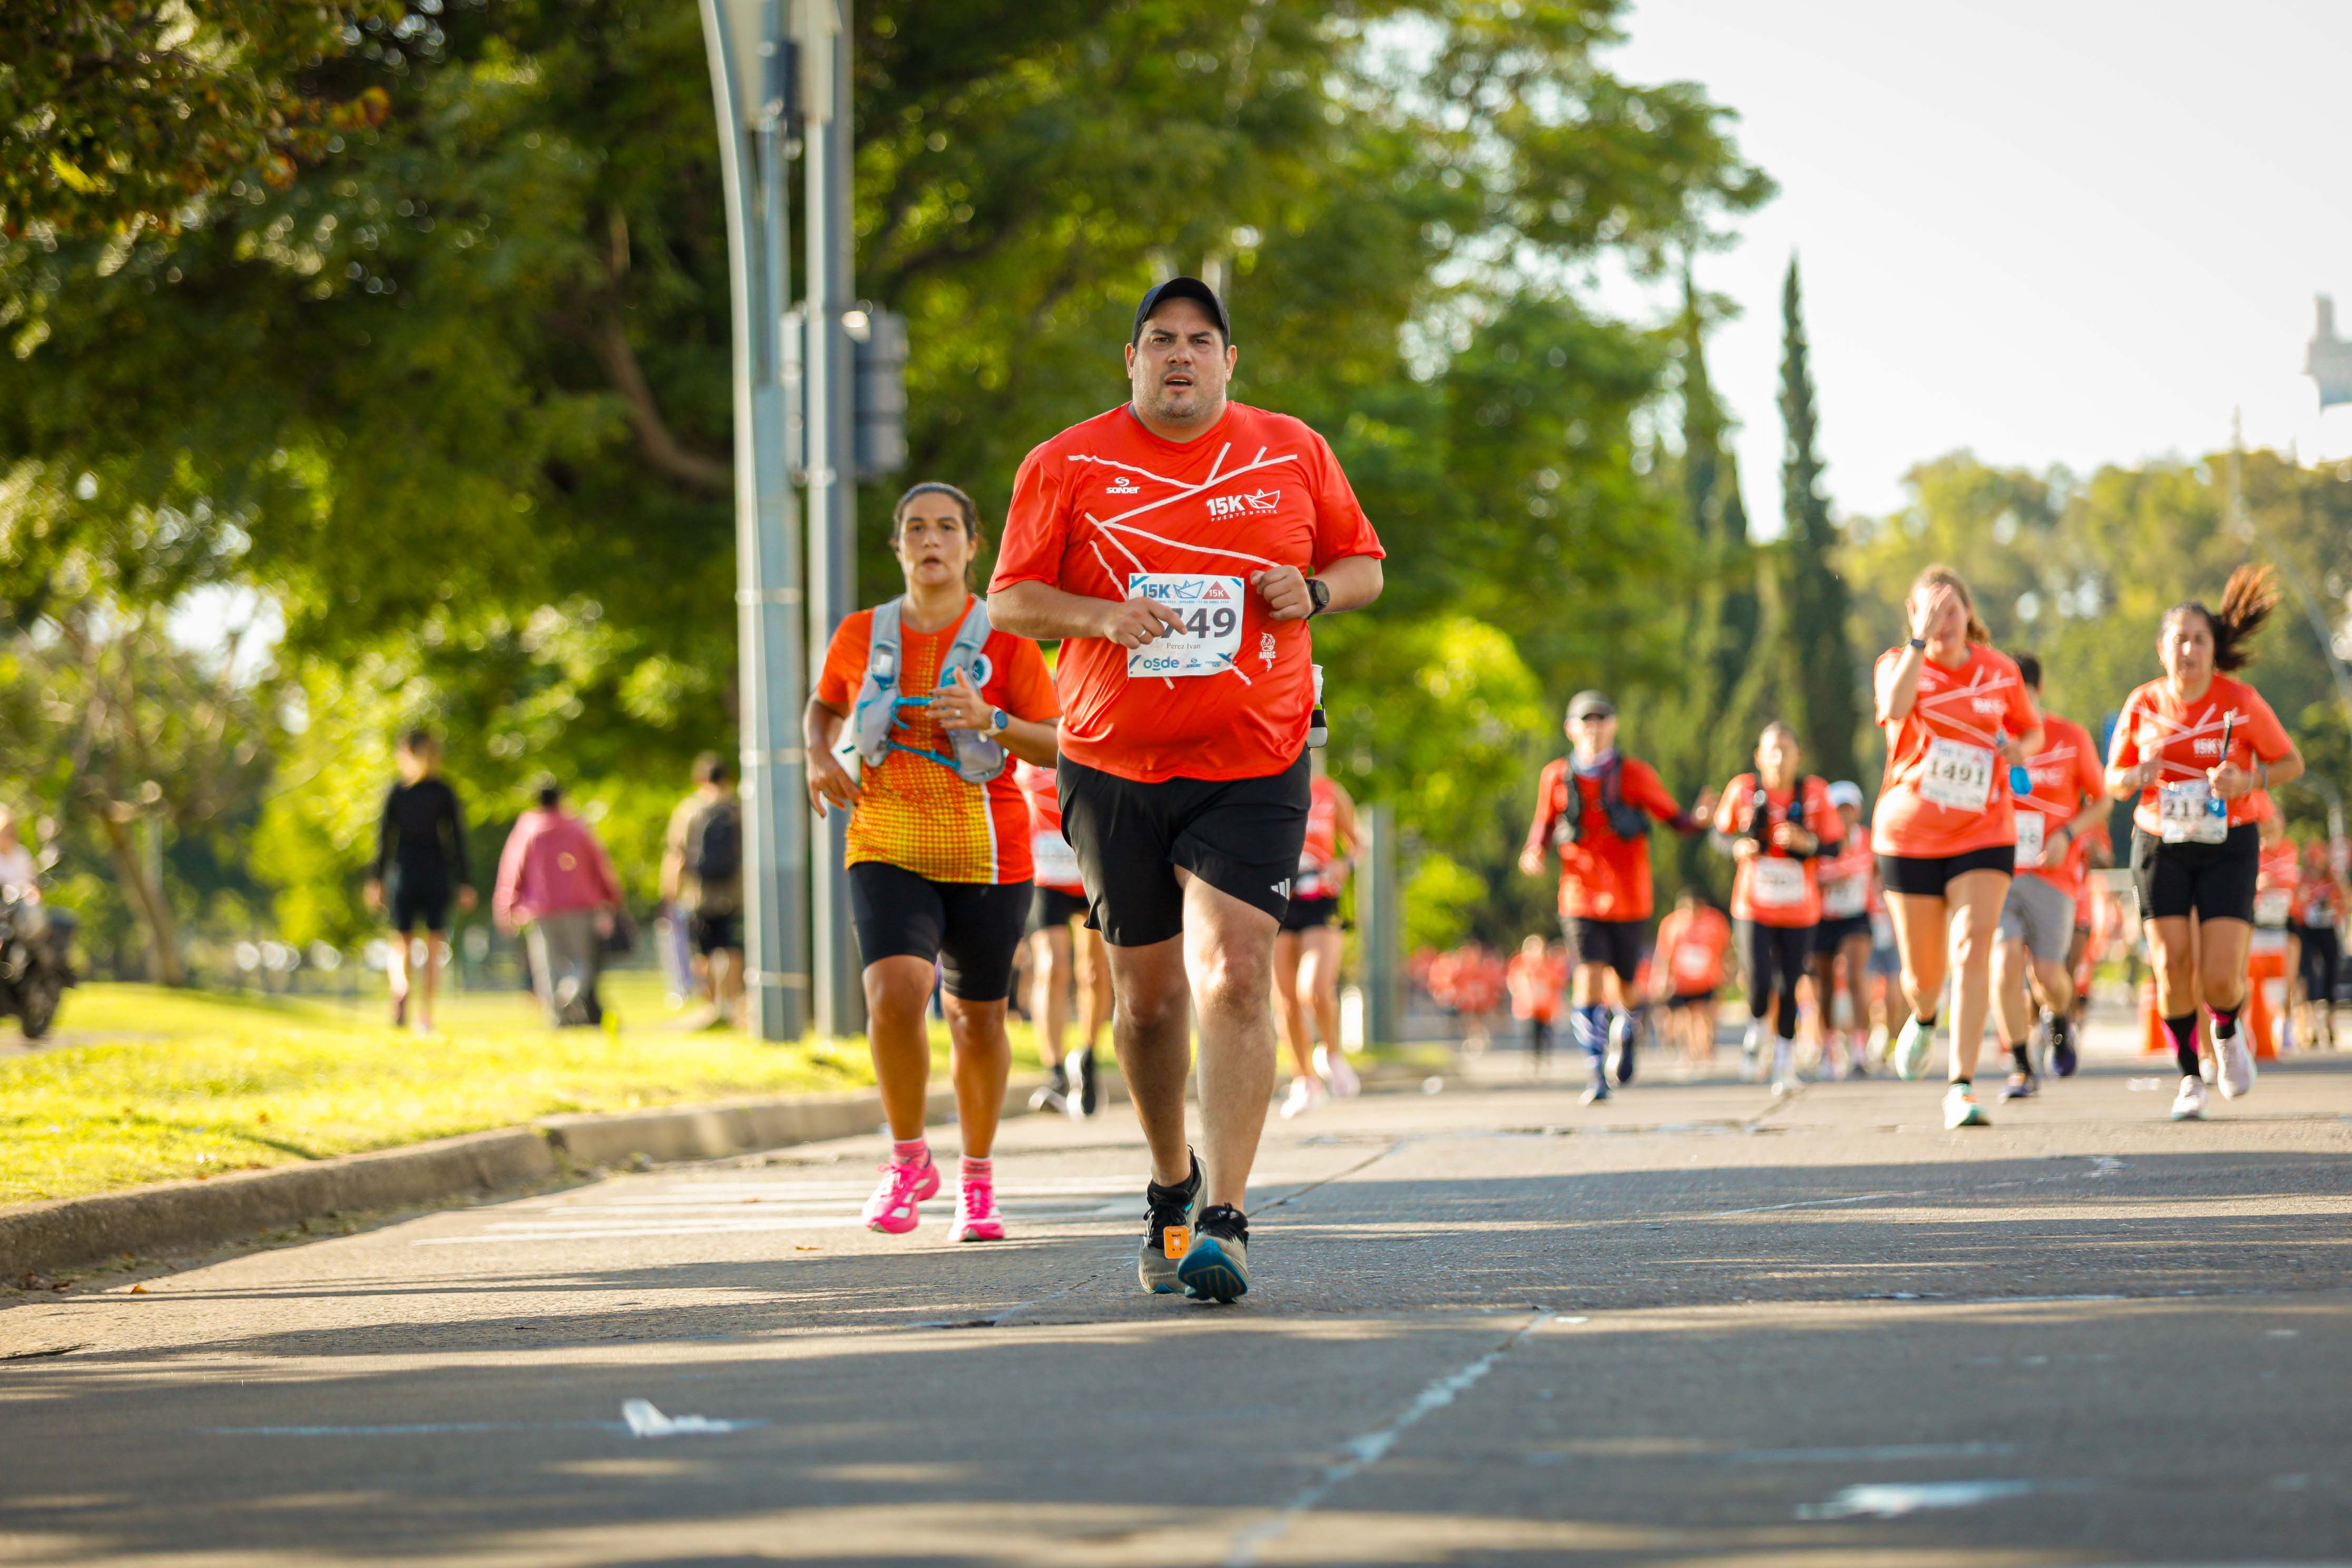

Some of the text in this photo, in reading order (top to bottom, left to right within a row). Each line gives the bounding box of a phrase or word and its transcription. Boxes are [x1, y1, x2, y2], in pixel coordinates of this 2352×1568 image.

[1206, 495, 1246, 516] 15K
[1211, 512, 1246, 522] PUERTO
[1141, 583, 1171, 599] 15K
[1259, 651, 1276, 659] ARDEC
[1143, 657, 1180, 669] osde
[1929, 758, 1985, 785] 1491
